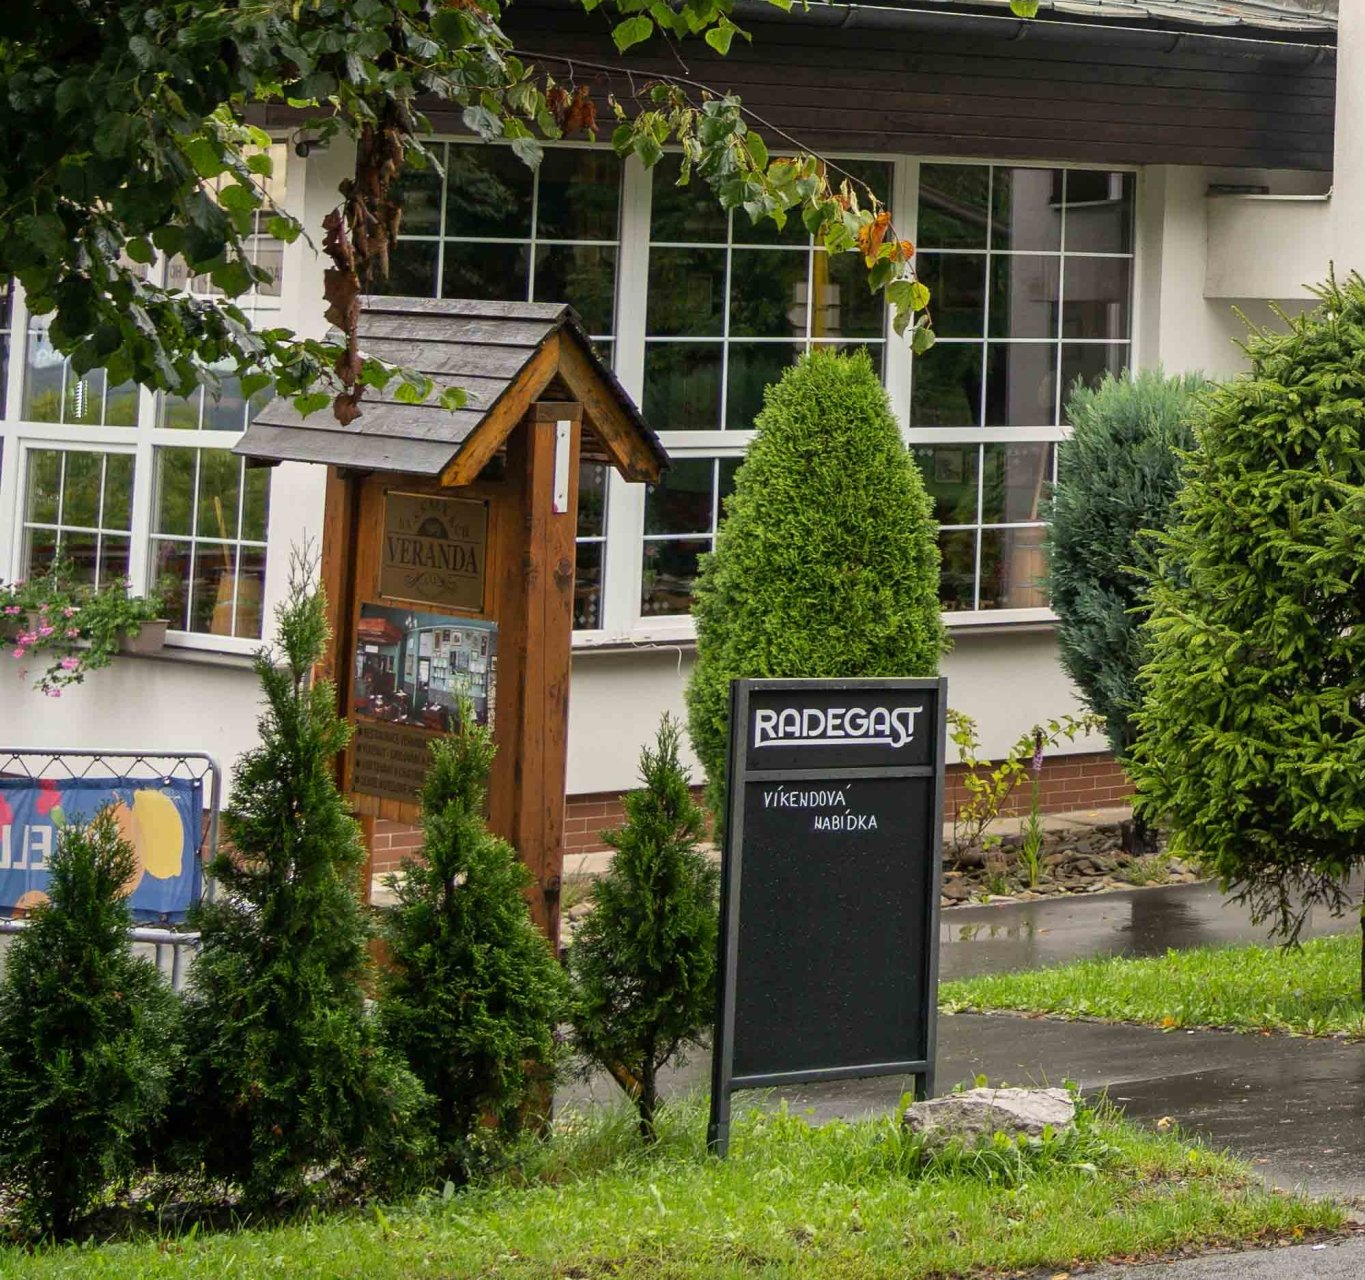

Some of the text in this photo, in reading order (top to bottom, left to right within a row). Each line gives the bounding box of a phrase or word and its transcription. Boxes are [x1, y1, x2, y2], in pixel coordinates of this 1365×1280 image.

[387, 535, 478, 574] VERANDA
[755, 706, 923, 748] RADEGAST
[764, 784, 851, 808] VÍKENDOVÁ
[814, 809, 878, 830] NABÍDKA
